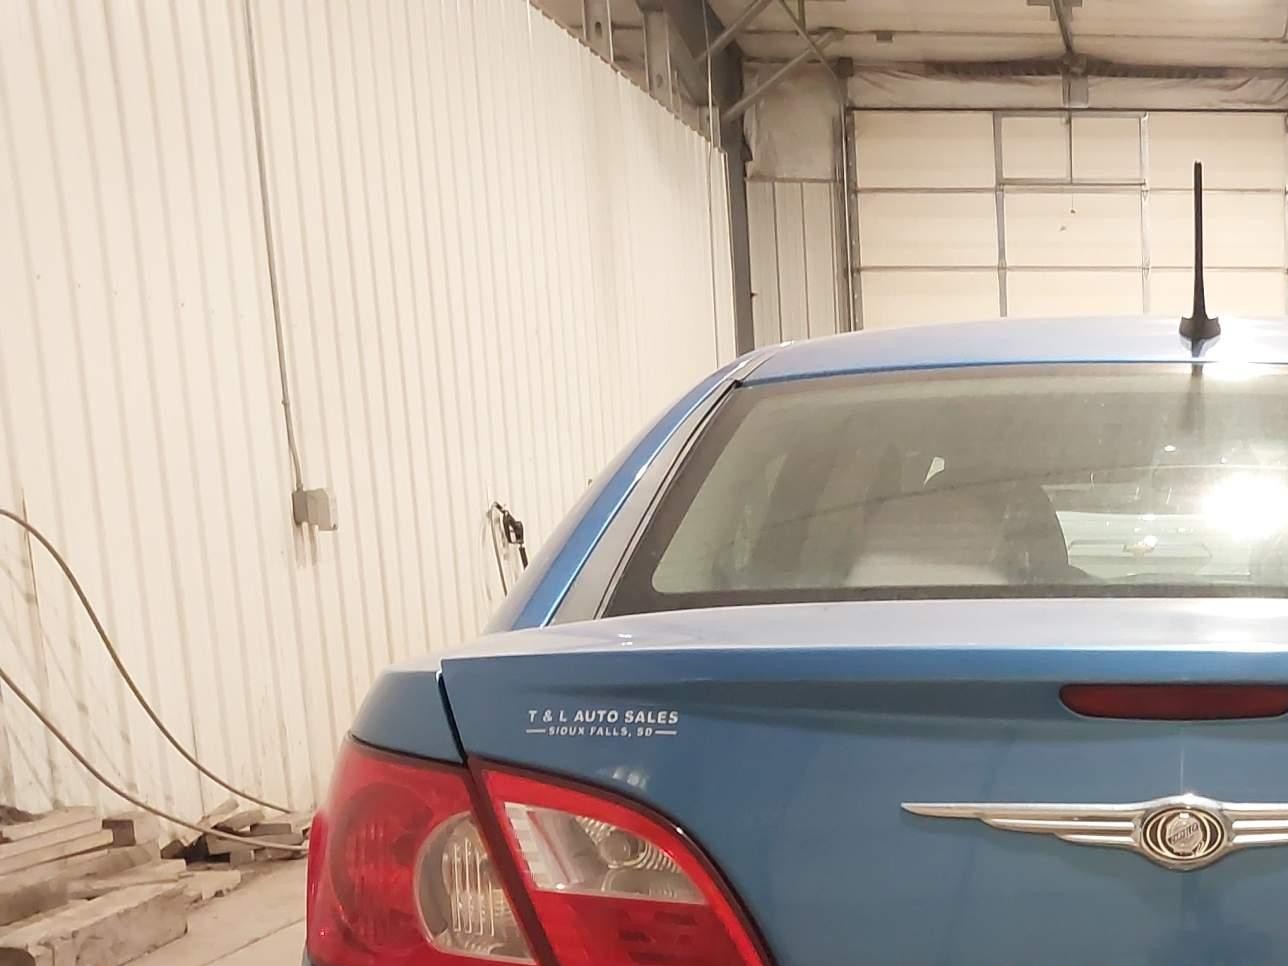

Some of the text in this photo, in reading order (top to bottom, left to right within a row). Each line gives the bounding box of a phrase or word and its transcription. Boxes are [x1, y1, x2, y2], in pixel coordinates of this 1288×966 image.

[528, 710, 679, 724] T & L AUTO SALES
[548, 726, 653, 738] SIOUX FALLS, SD
